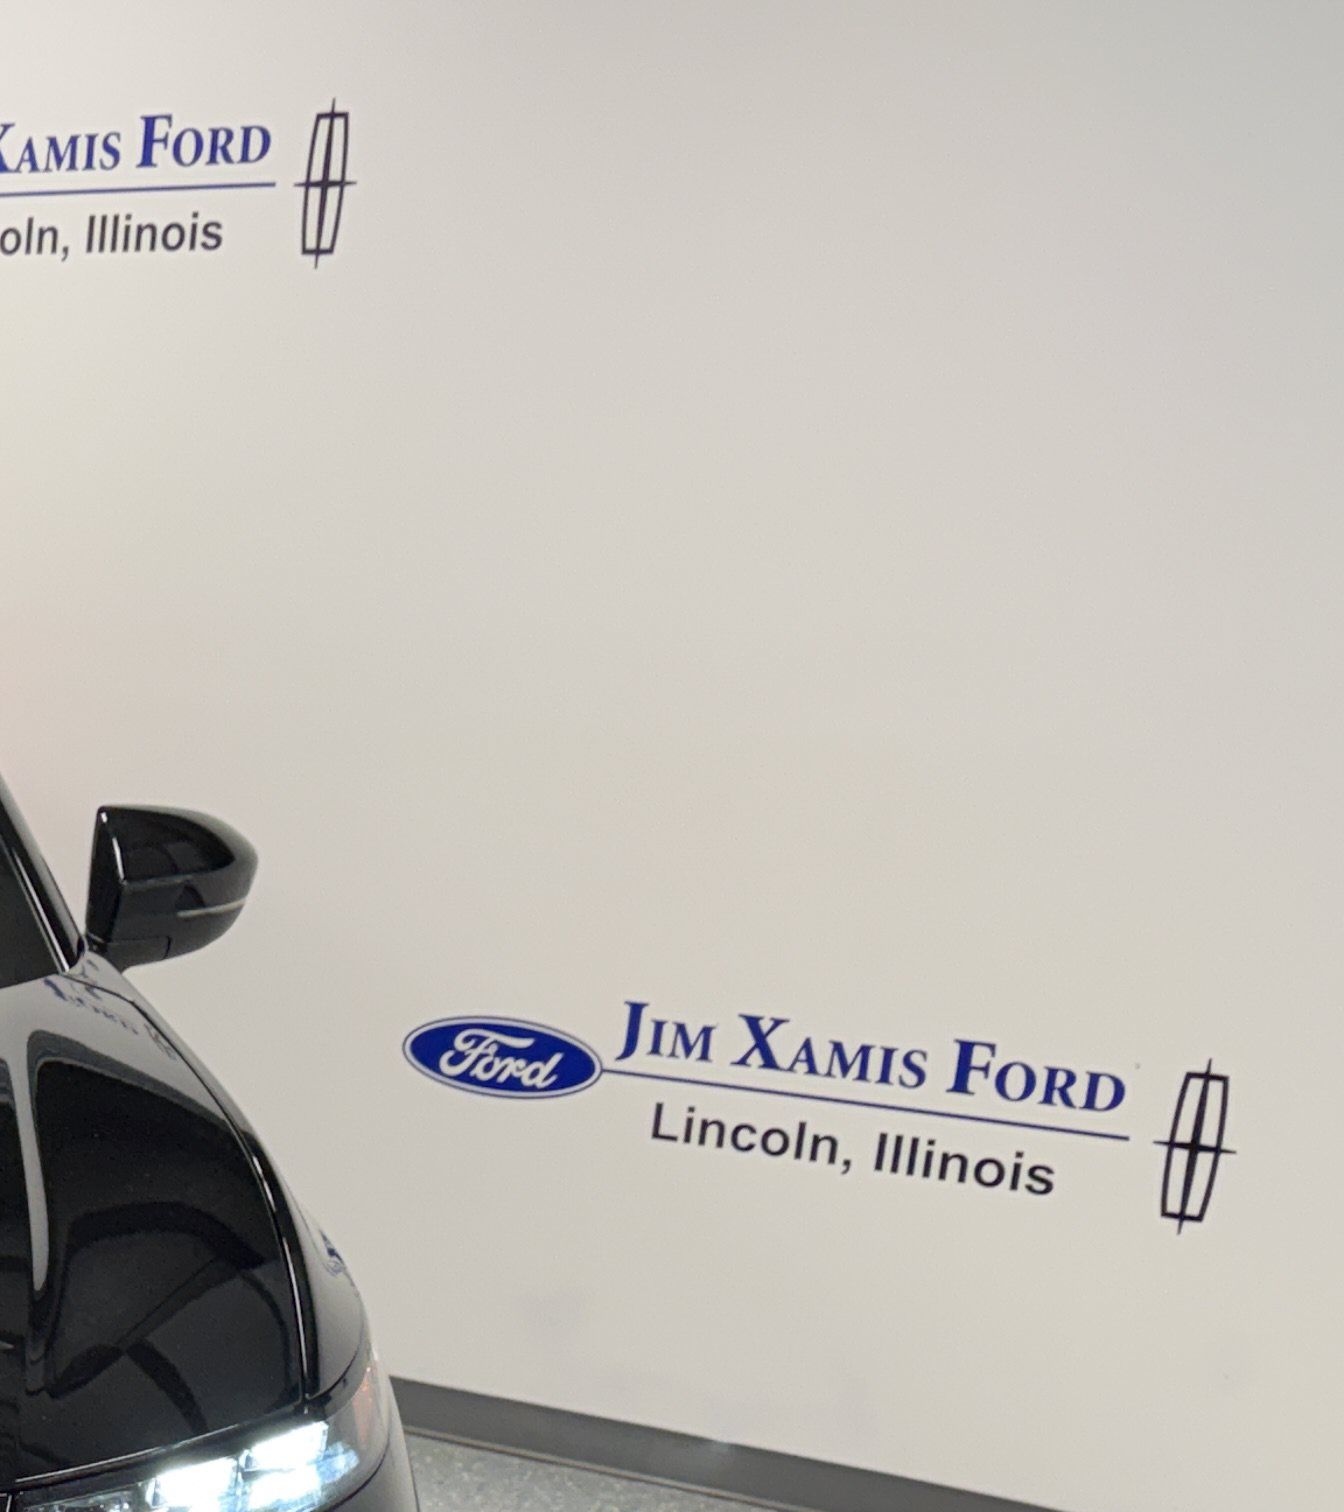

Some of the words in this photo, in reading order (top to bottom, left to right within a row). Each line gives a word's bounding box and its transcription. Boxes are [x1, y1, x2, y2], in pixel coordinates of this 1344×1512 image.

[85, 212, 223, 253] Illinois
[438, 1027, 559, 1090] Ford
[650, 1102, 853, 1175] Lincoln,
[873, 1133, 1056, 1196] Illinois
